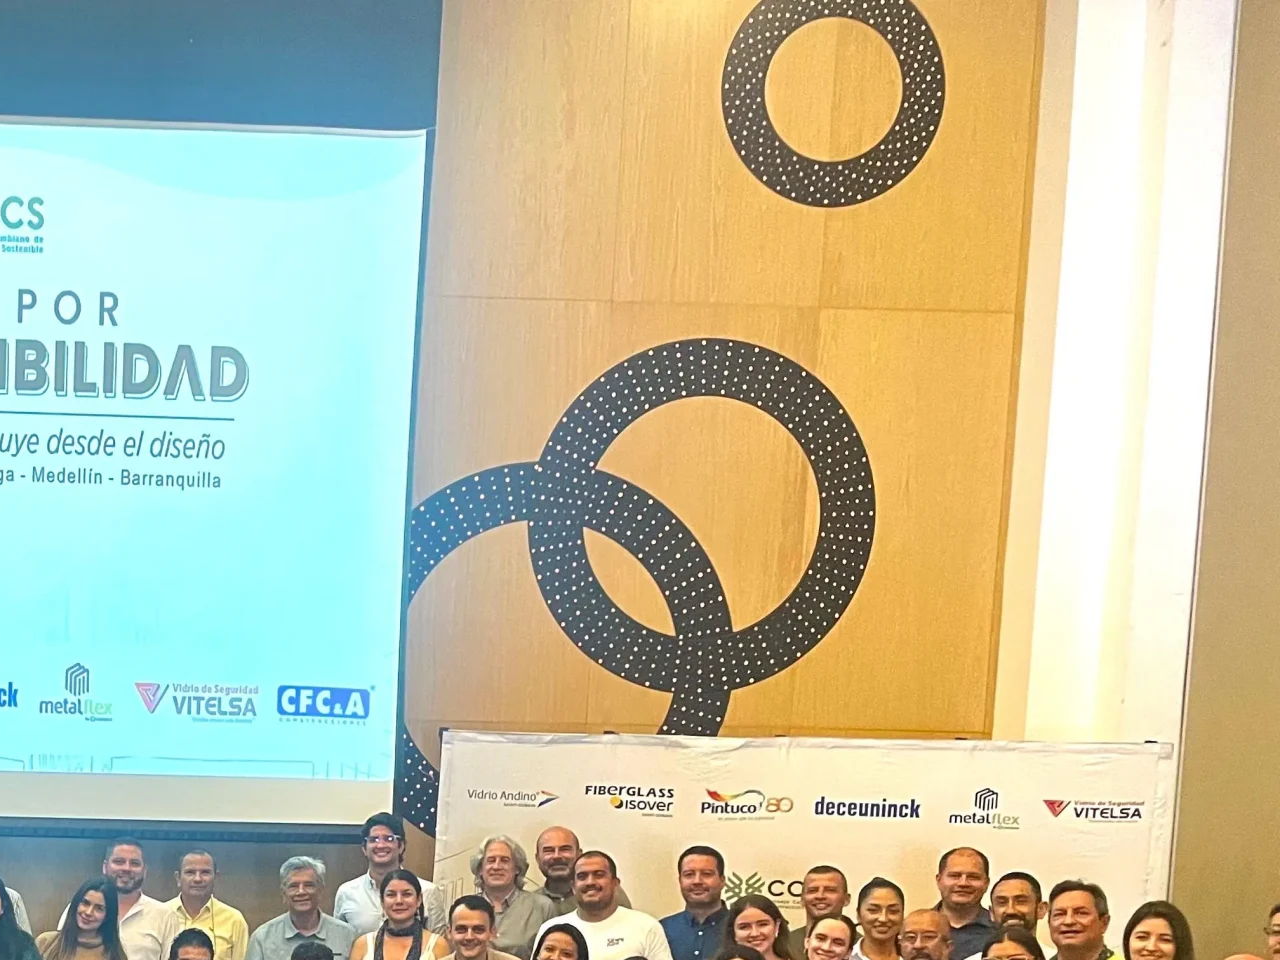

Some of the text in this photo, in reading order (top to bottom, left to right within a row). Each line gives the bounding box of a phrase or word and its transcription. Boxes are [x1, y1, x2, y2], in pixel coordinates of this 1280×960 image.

[1, 244, 44, 253] Sostenible
[17, 288, 119, 327] POR
[46, 427, 116, 457] desde
[123, 430, 144, 457] el
[149, 431, 226, 460] diseño
[32, 466, 103, 484] Medellín
[120, 469, 221, 490] Barranquilla
[172, 683, 259, 698] Vidrio de Seguridad
[39, 698, 113, 716] metalflex
[172, 696, 257, 717] VITELSA
[467, 789, 537, 801] Vidrio Andino
[701, 801, 757, 814] Pintuco
[814, 796, 921, 819] deceuninck
[1073, 807, 1142, 819] VITELSA
[949, 812, 1020, 826] metalflex
